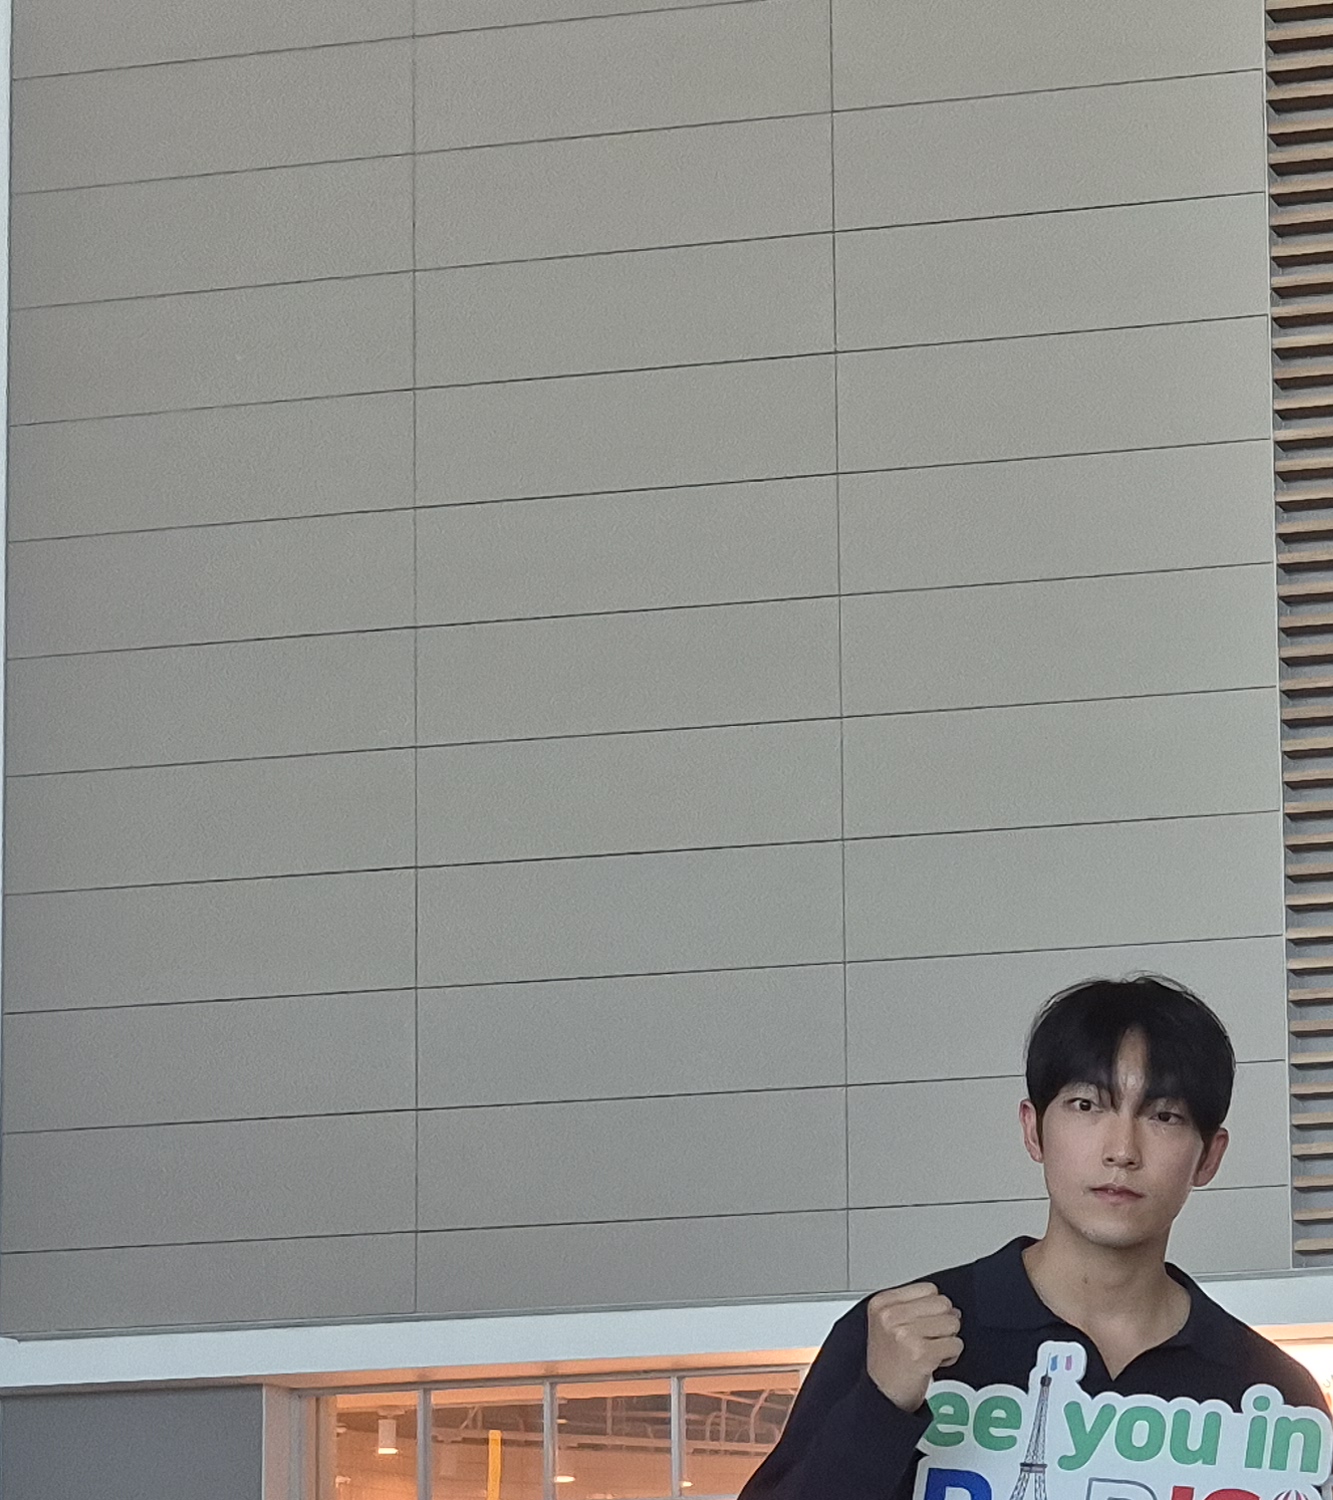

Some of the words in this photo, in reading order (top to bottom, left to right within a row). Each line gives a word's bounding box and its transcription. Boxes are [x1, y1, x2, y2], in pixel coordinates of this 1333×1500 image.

[924, 1391, 1022, 1451] ee
[1057, 1401, 1220, 1470] you
[1244, 1396, 1322, 1474] in
